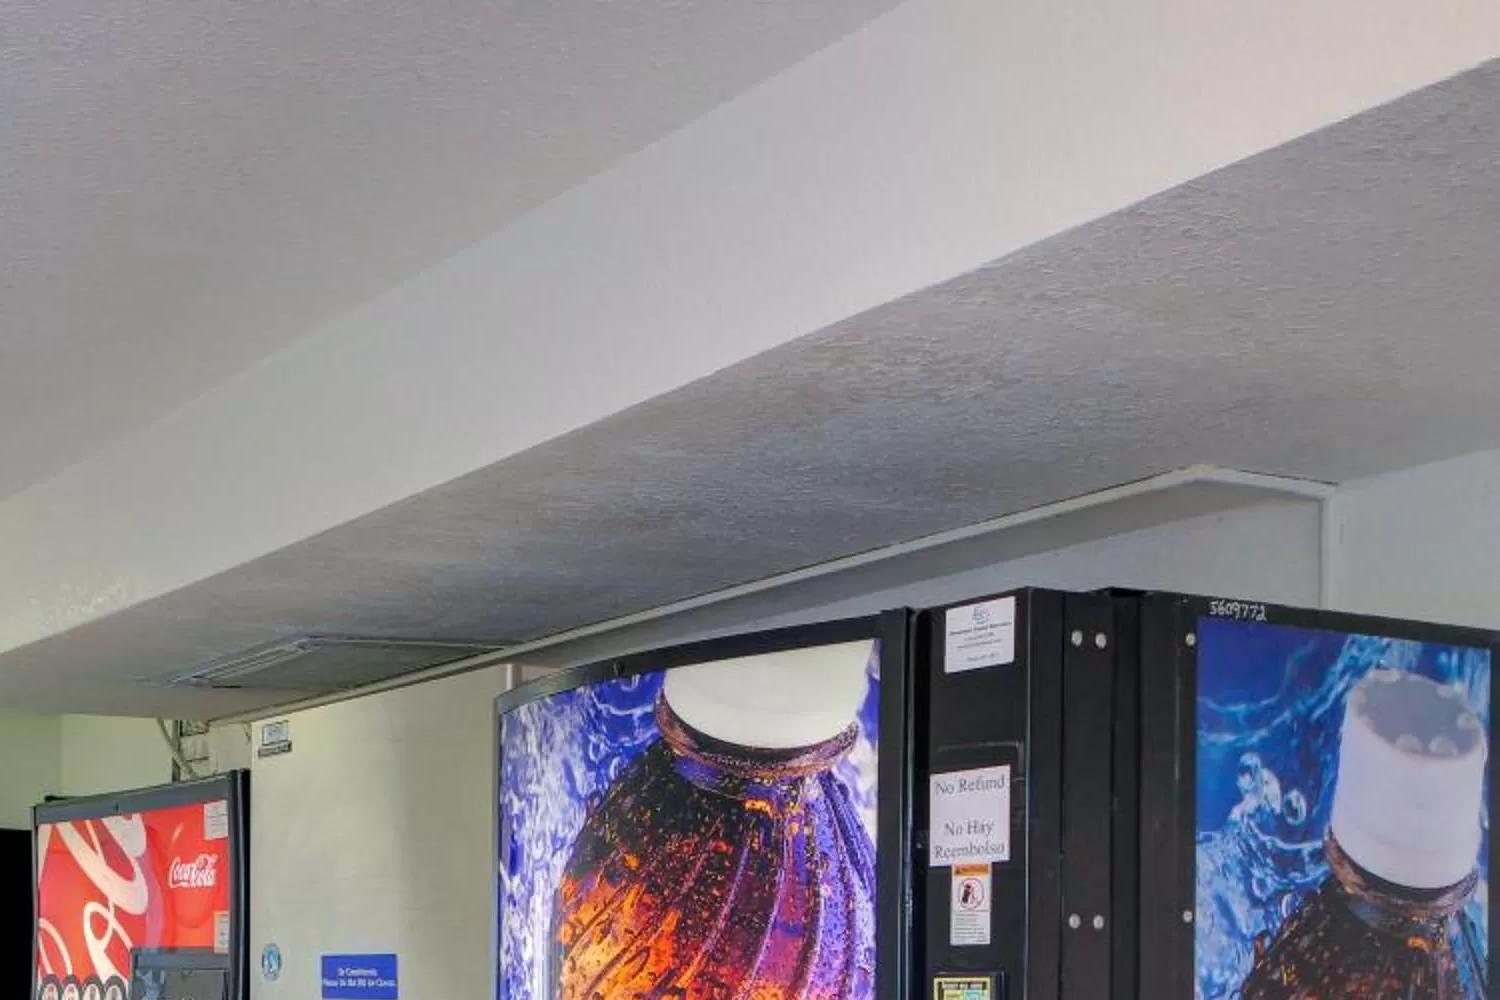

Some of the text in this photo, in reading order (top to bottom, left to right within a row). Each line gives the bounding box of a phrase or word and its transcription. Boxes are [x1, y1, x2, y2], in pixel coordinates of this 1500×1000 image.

[935, 773, 1005, 795] No Refund
[945, 819, 994, 838] No Hay
